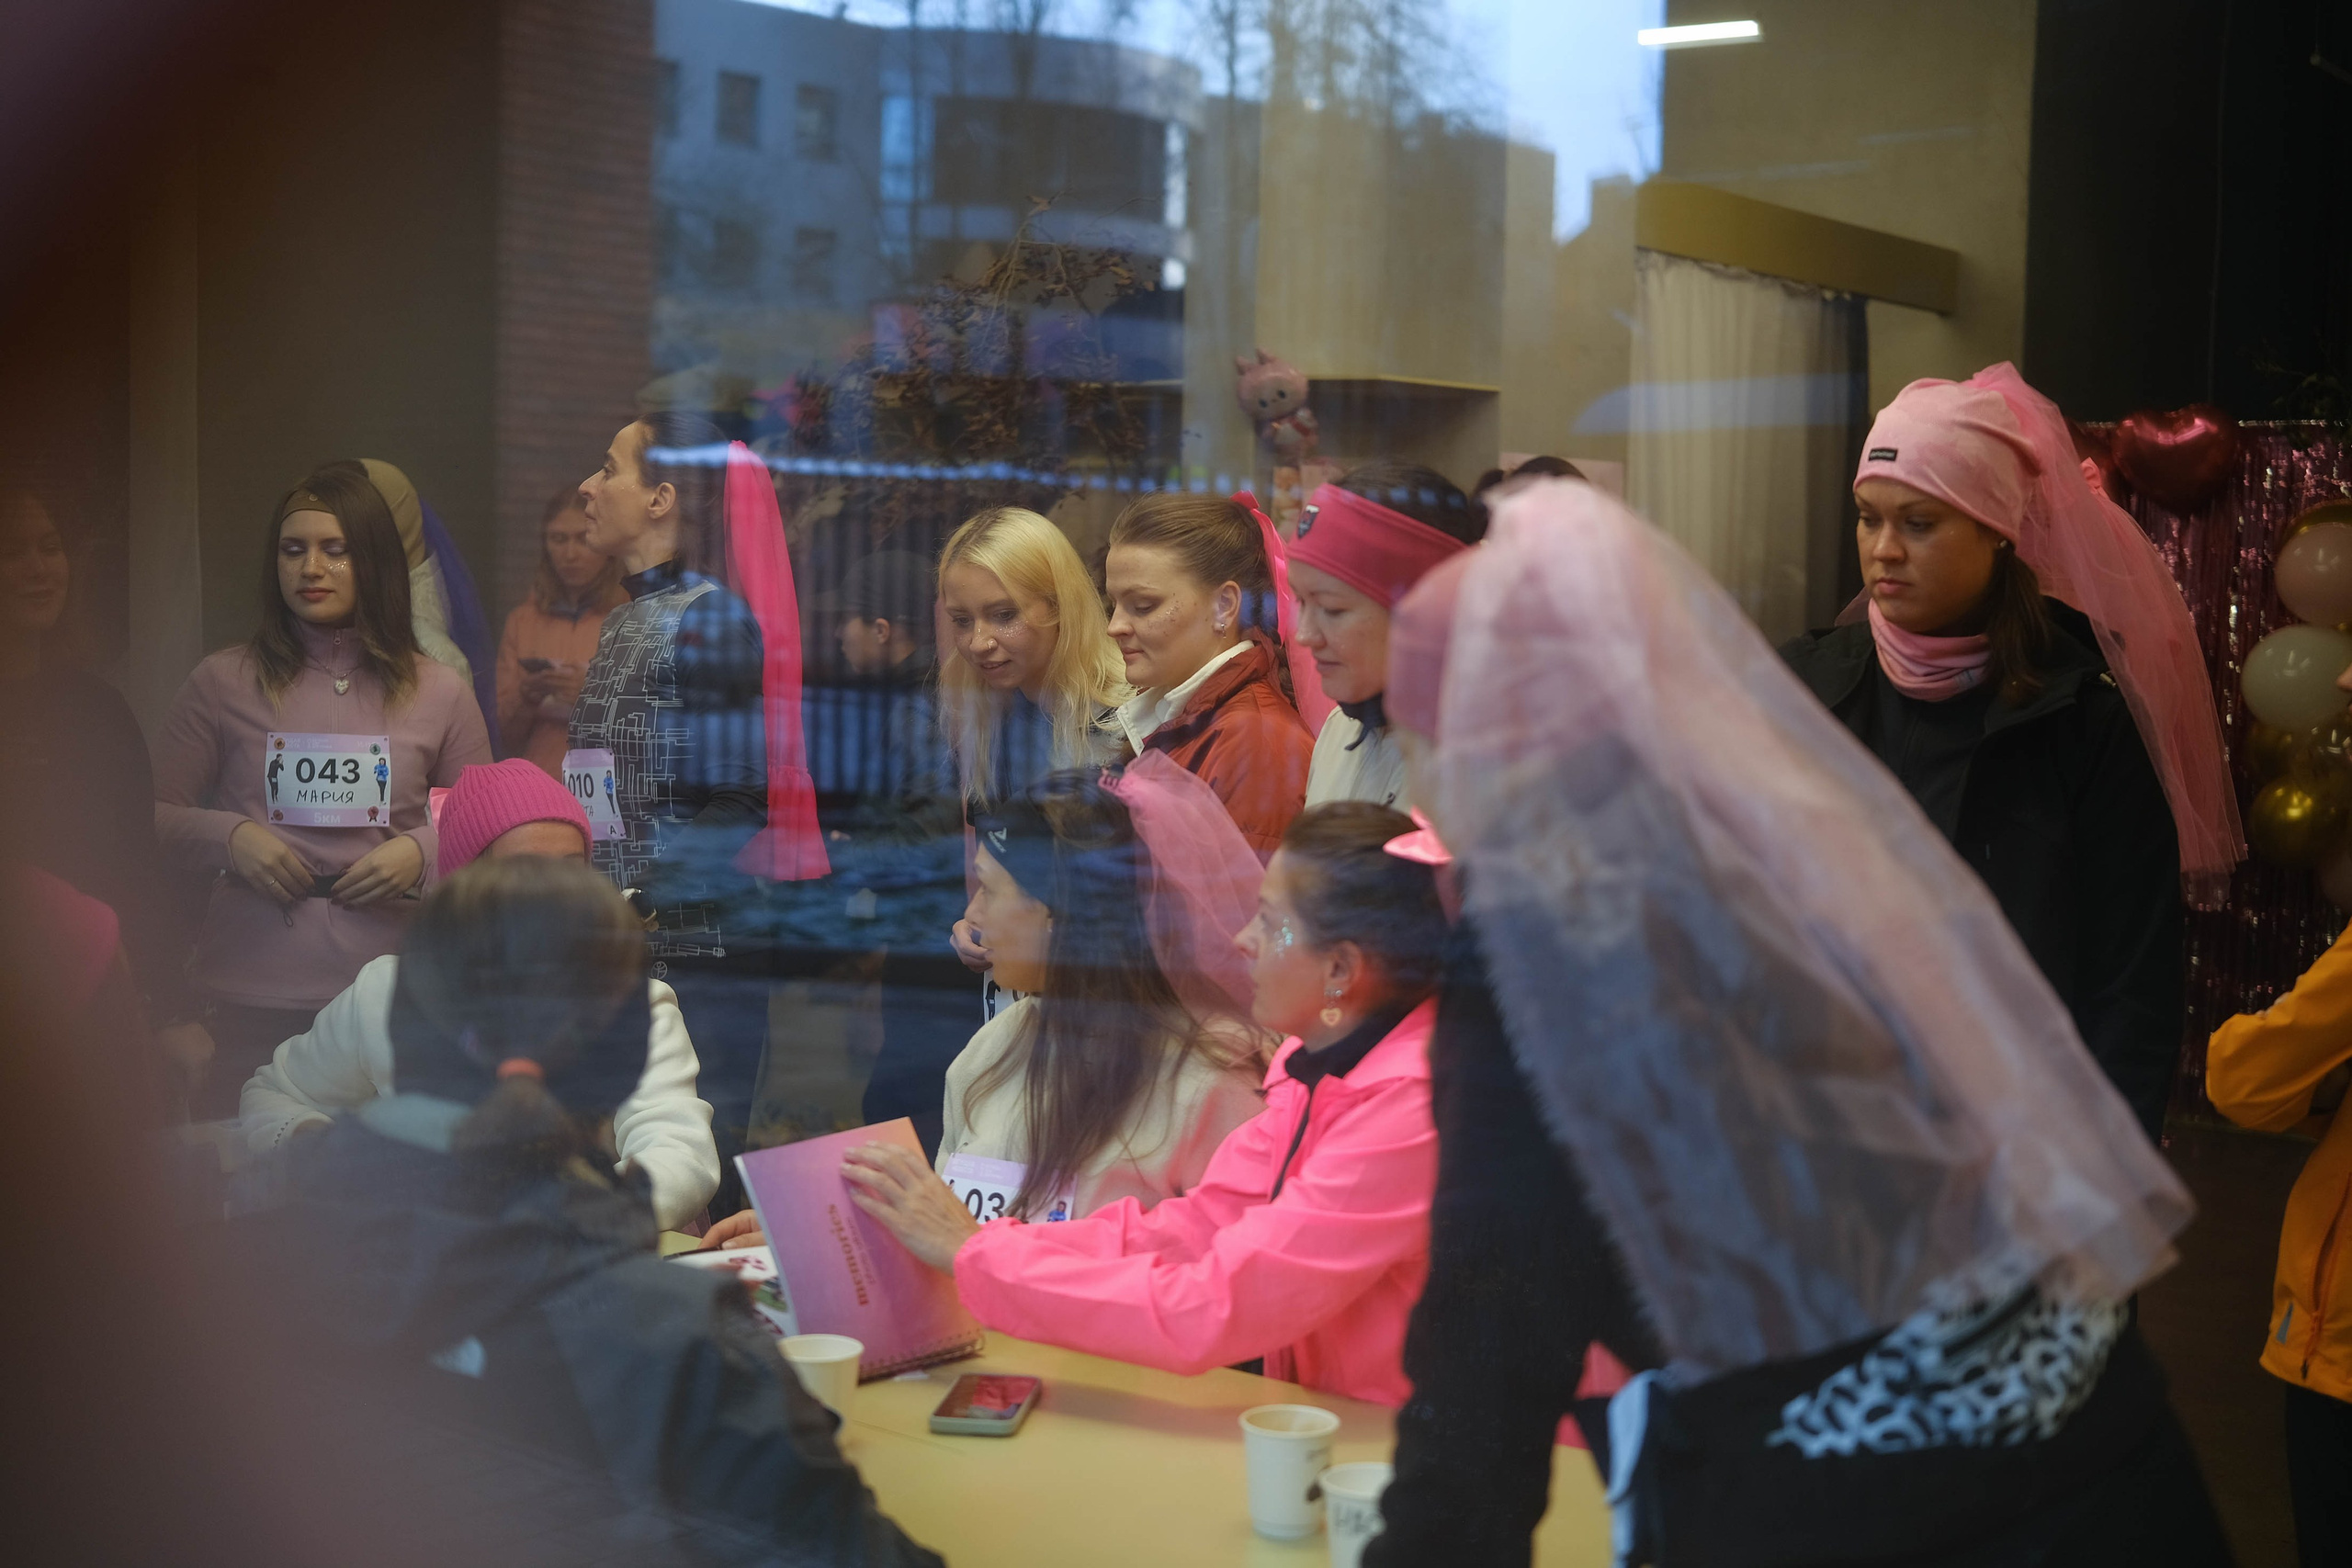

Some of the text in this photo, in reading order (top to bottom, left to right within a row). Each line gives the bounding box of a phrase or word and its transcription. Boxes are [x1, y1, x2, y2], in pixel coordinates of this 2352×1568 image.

[295, 757, 361, 784] 043
[296, 789, 355, 804] МАРИЯ
[568, 773, 594, 798] 010
[828, 1203, 870, 1306] memories
